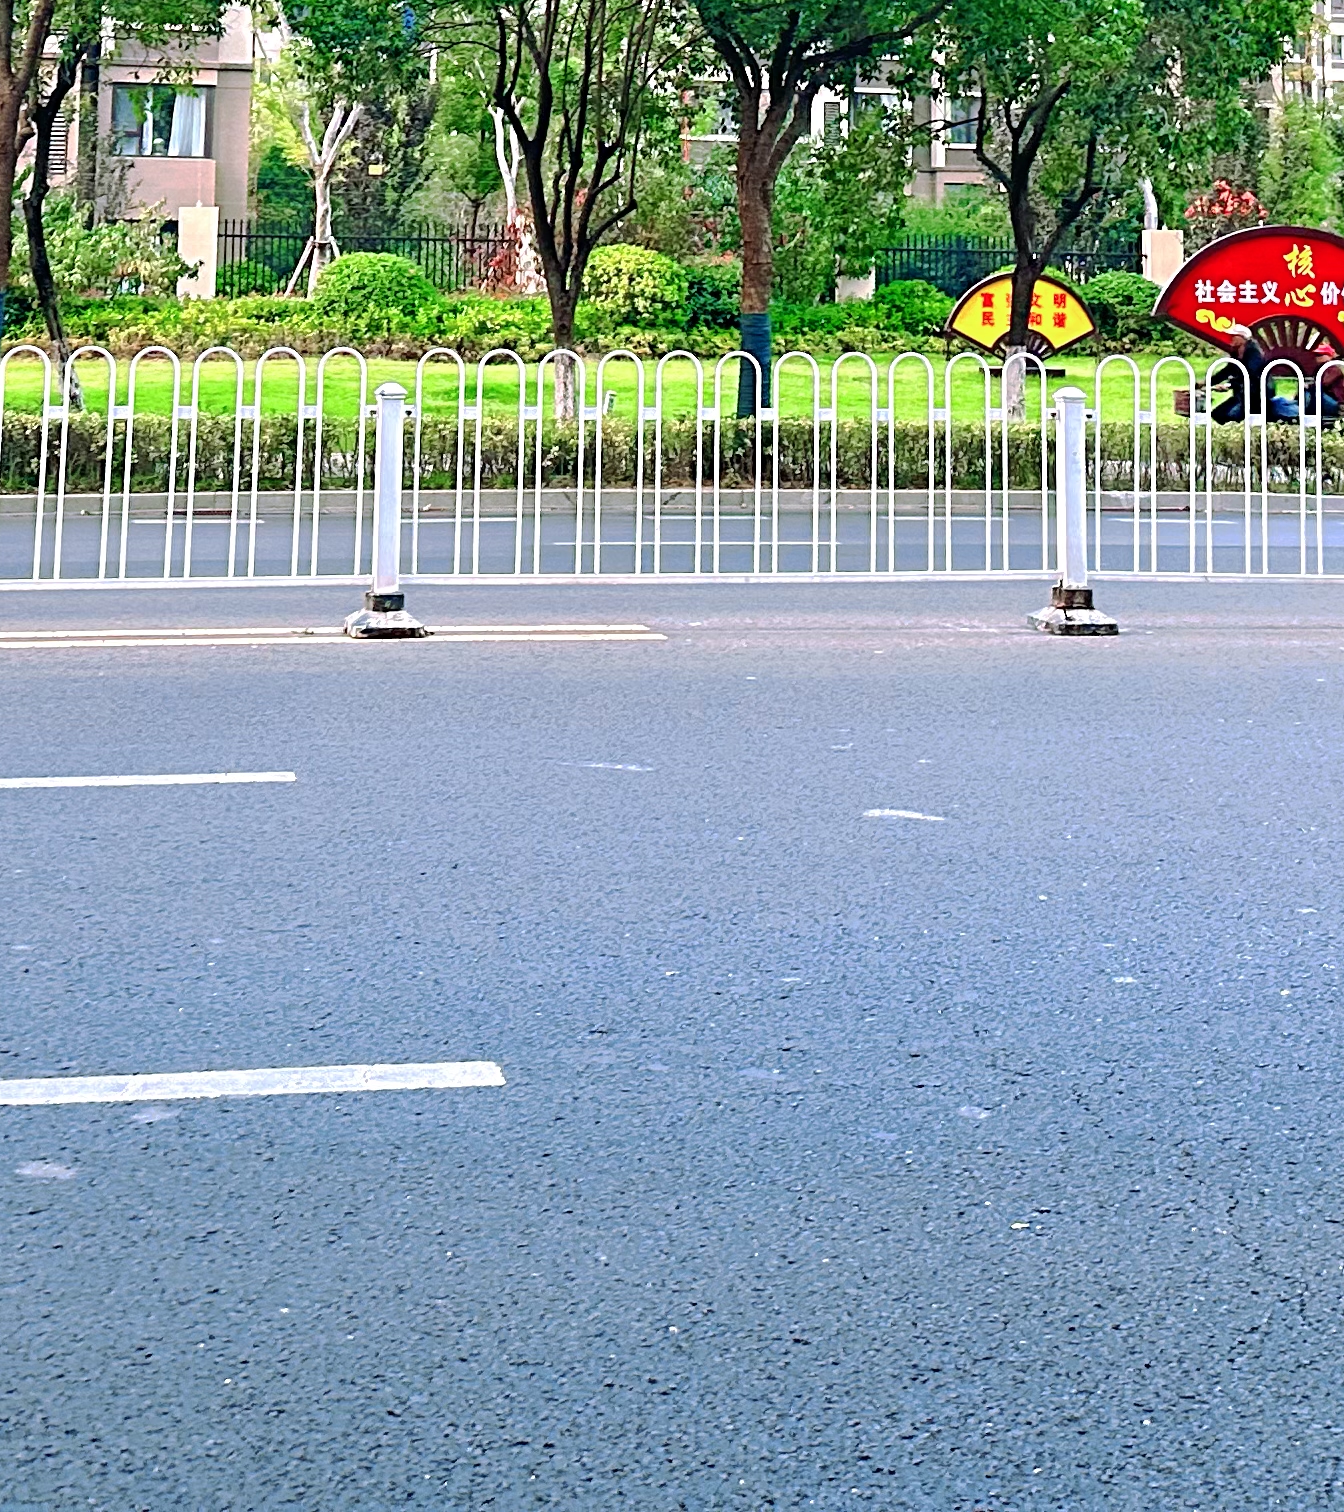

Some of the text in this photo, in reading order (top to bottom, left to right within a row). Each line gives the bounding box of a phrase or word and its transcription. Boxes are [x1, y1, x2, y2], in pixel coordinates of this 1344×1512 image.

[1283, 243, 1316, 308] 核心
[1031, 293, 1067, 309] 文明
[1194, 279, 1281, 304] 社会主义
[1029, 312, 1067, 329] 和谐
